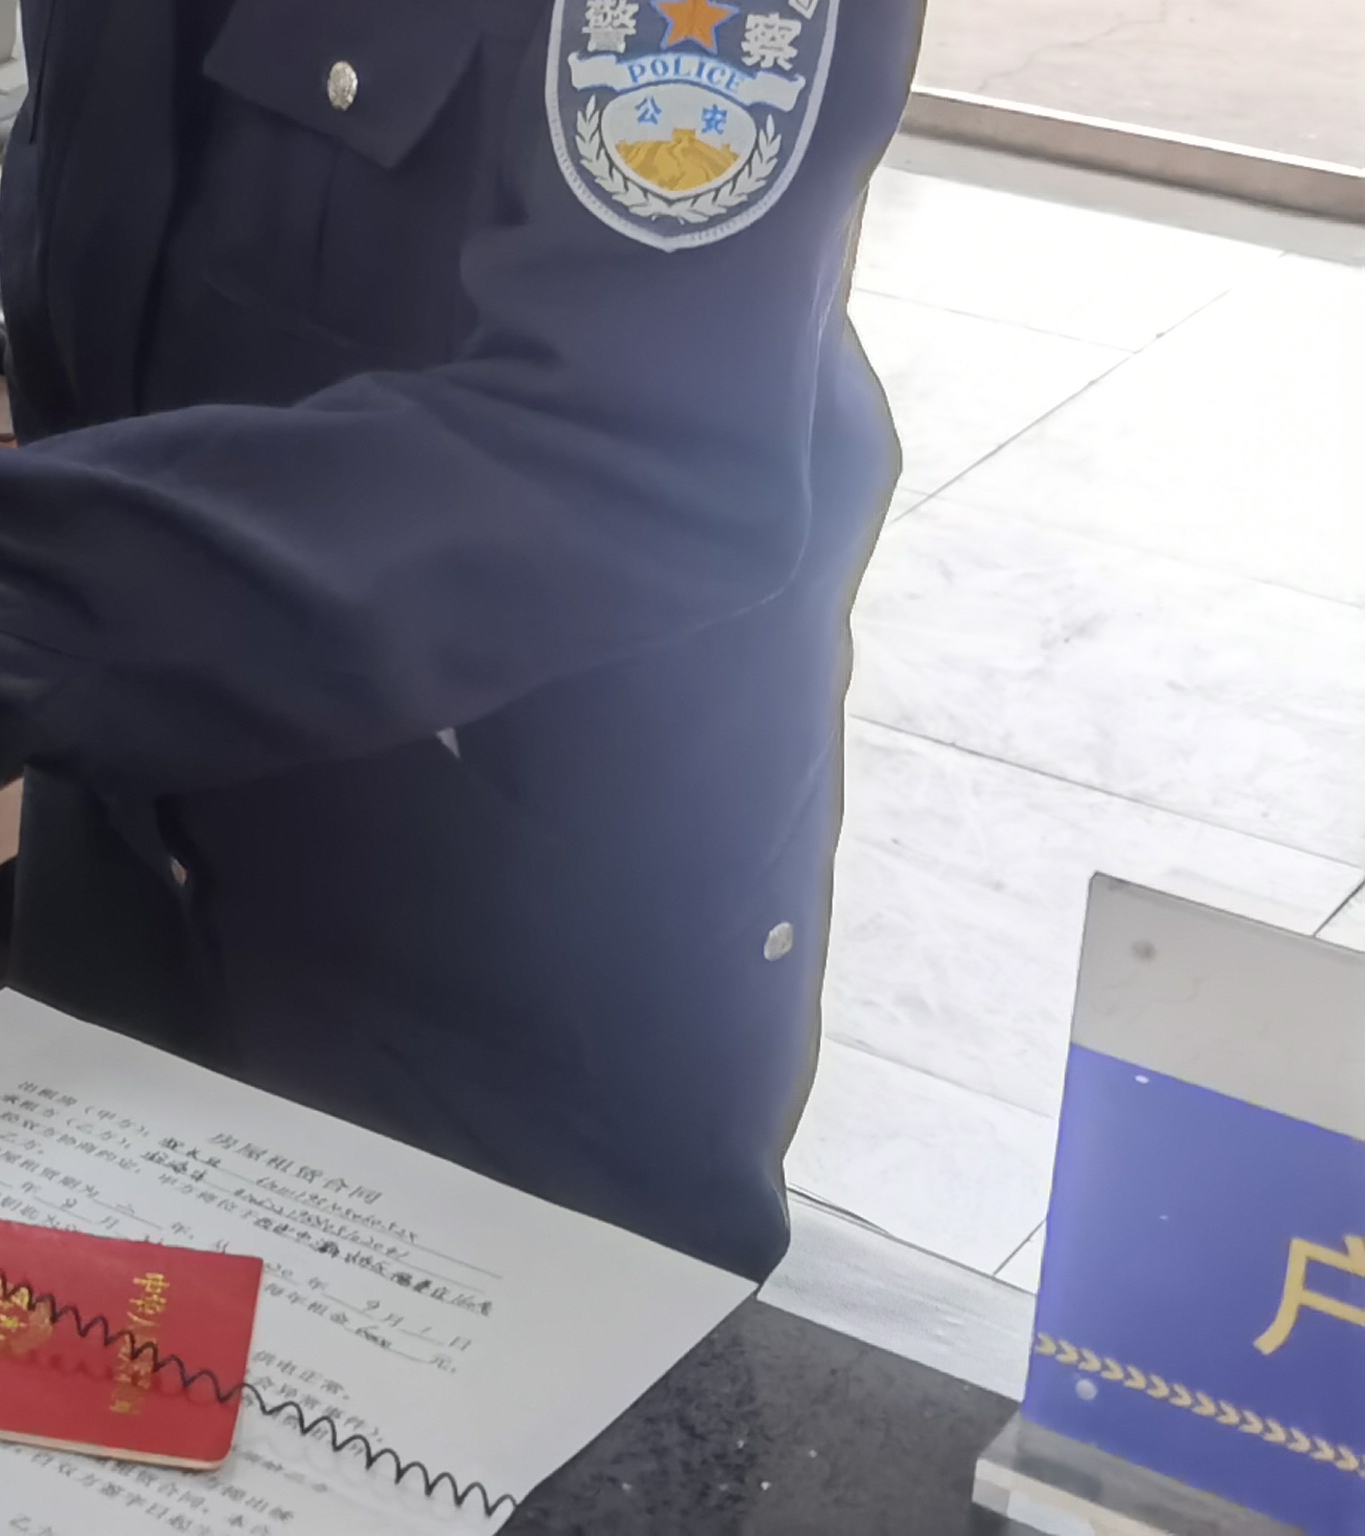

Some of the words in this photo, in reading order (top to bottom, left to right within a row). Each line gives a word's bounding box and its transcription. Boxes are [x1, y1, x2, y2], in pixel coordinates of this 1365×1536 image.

[742, 13, 803, 71] 察
[628, 60, 745, 93] POLICE
[635, 96, 663, 126] 公
[701, 104, 729, 135] 安
